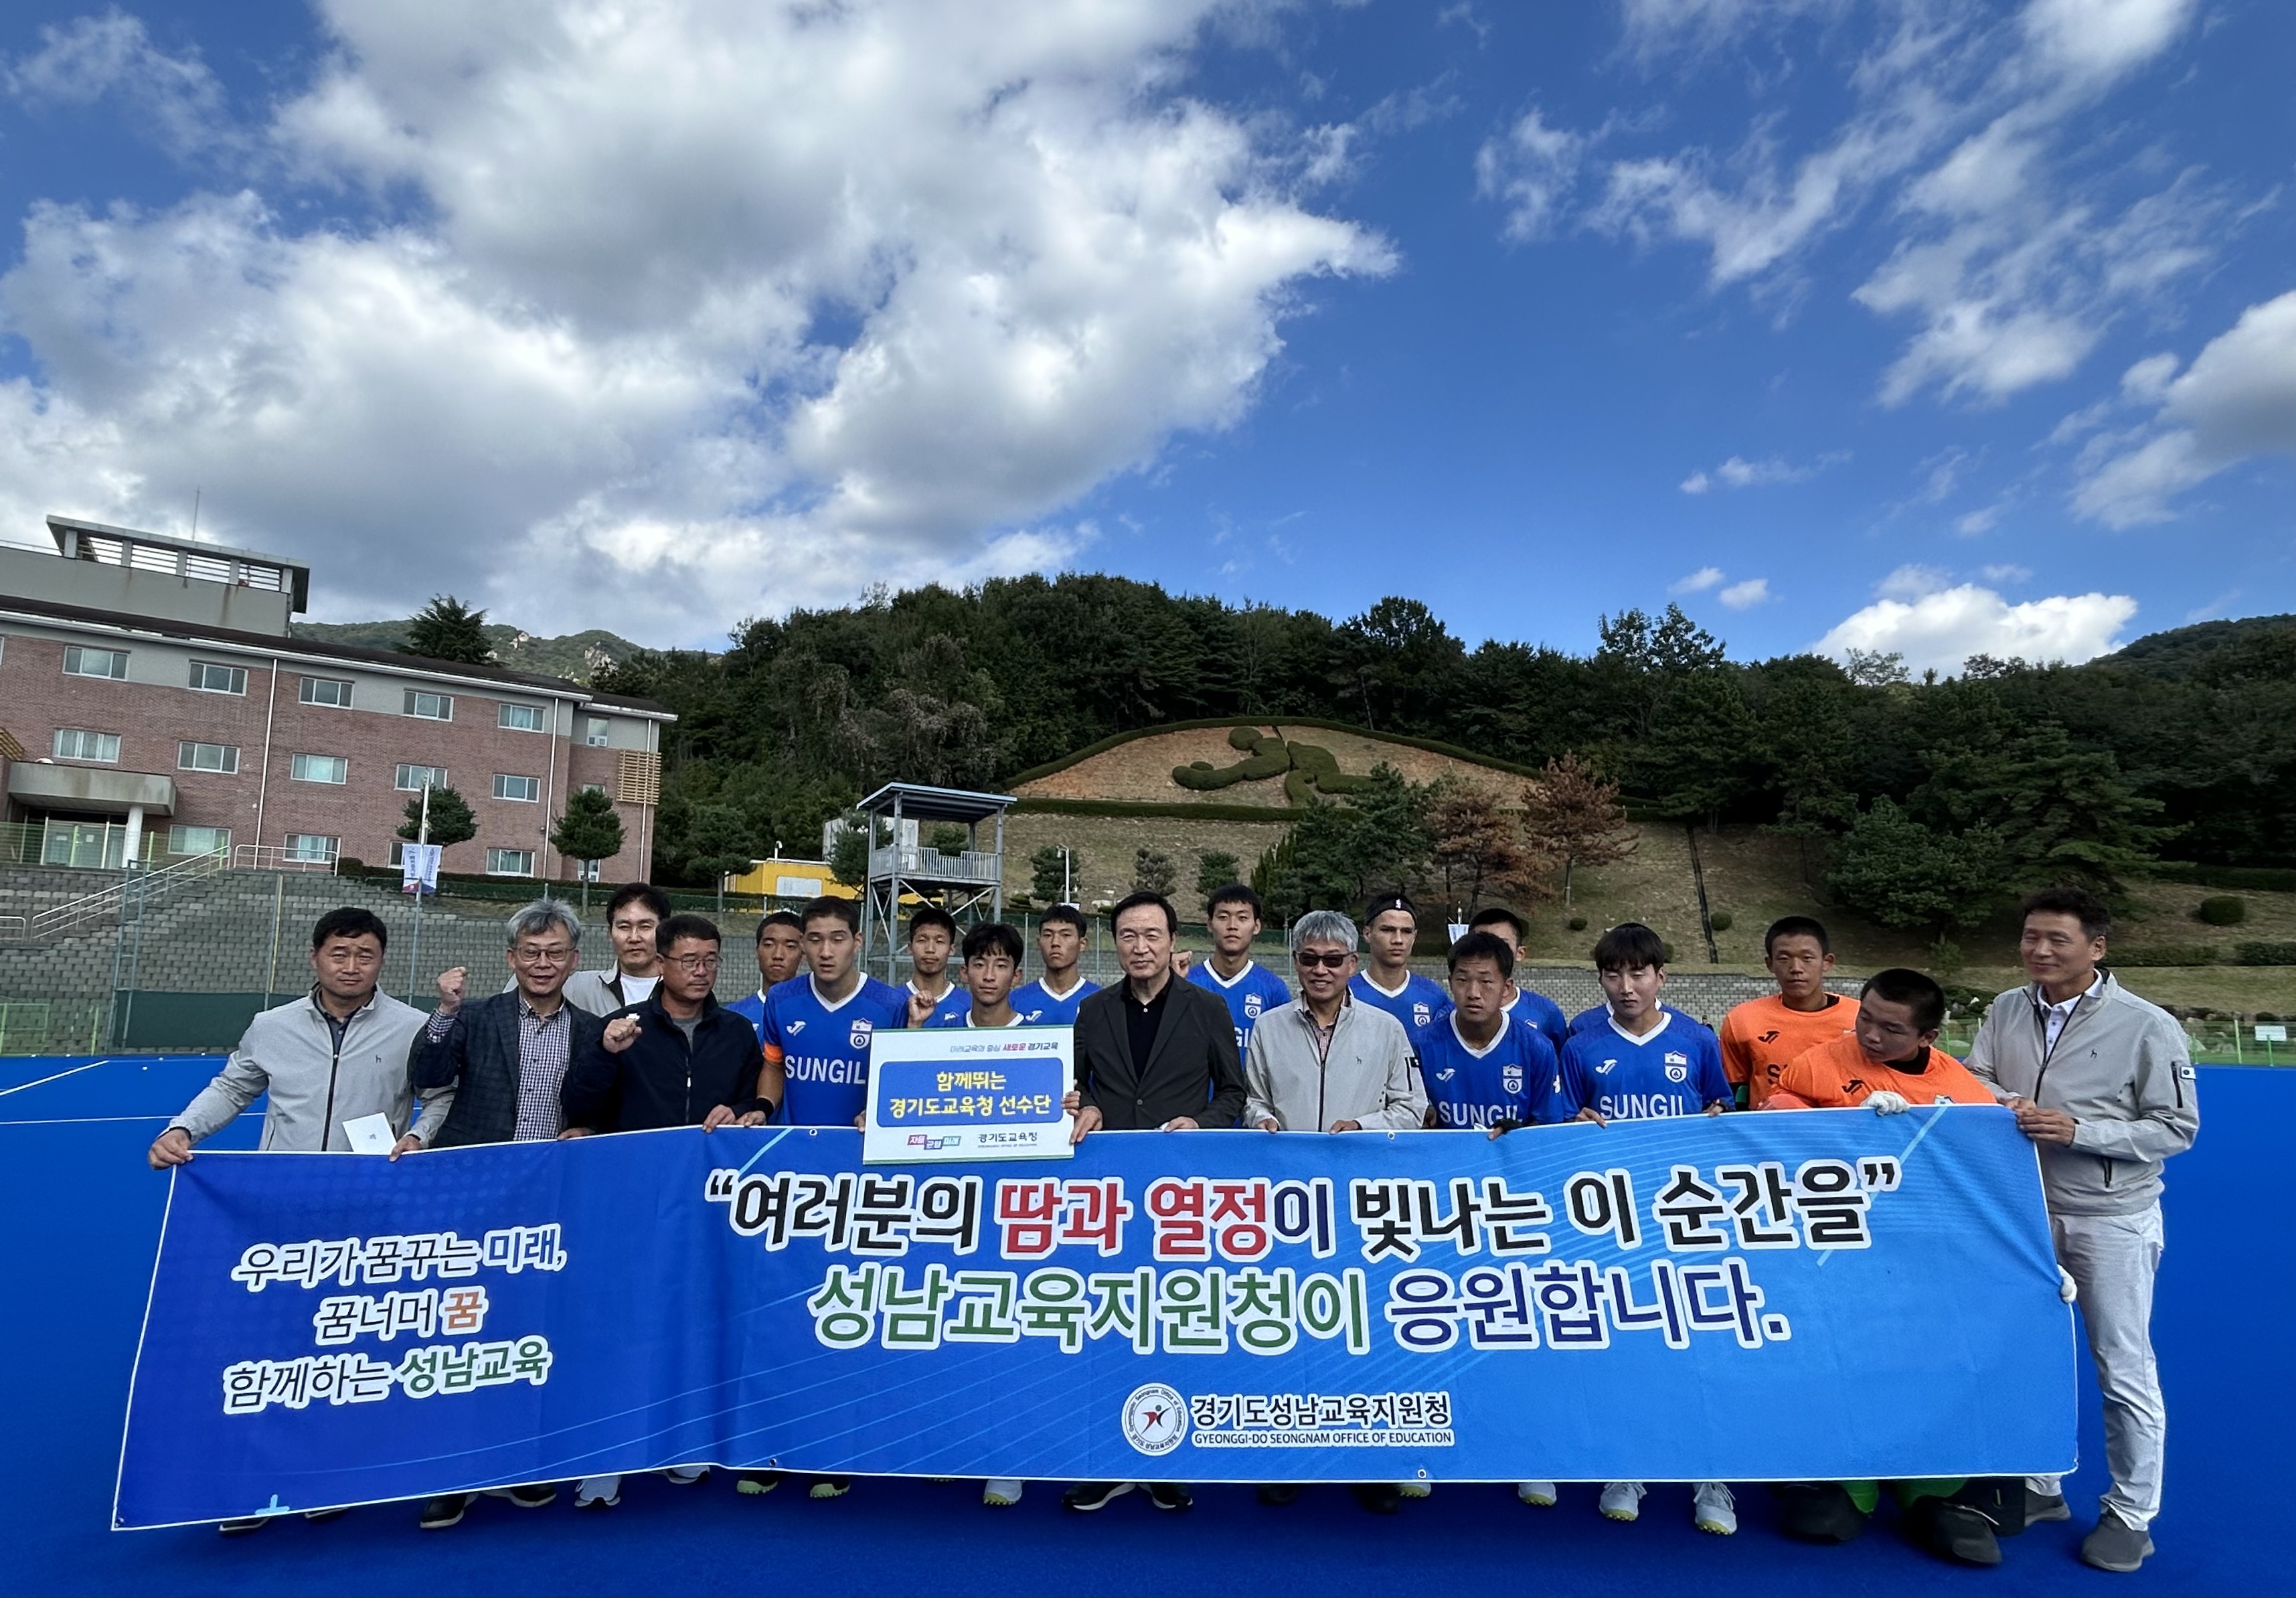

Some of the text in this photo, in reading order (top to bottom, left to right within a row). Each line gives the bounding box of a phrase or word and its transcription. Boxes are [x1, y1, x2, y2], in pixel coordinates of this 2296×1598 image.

[1003, 1042, 1027, 1051] 새로운
[1028, 1042, 1058, 1050] 경기교육
[785, 1055, 866, 1085] SUNGIL
[936, 1071, 1007, 1092] 함께뛰는
[890, 1094, 1052, 1119] 경기도교육청 선수단
[1000, 1183, 1127, 1253] 땀과
[1150, 1183, 1329, 1255] 열정이
[1356, 1182, 1546, 1257] 빛나는
[1570, 1175, 1635, 1243] 이
[238, 1228, 563, 1285] 우리가 꿈꾸는 미래,
[319, 1291, 483, 1340] 꿈너머 꿈
[813, 1263, 1783, 1348] 성남교육지원청이 응원합니다.
[230, 1340, 549, 1407] 함께하는 성남교육
[1194, 1395, 1449, 1427] 경기도성남교육지원청
[1195, 1432, 1451, 1444] GYEONGGI-DO SEONGNAM OFFICE OF EDUCATION
